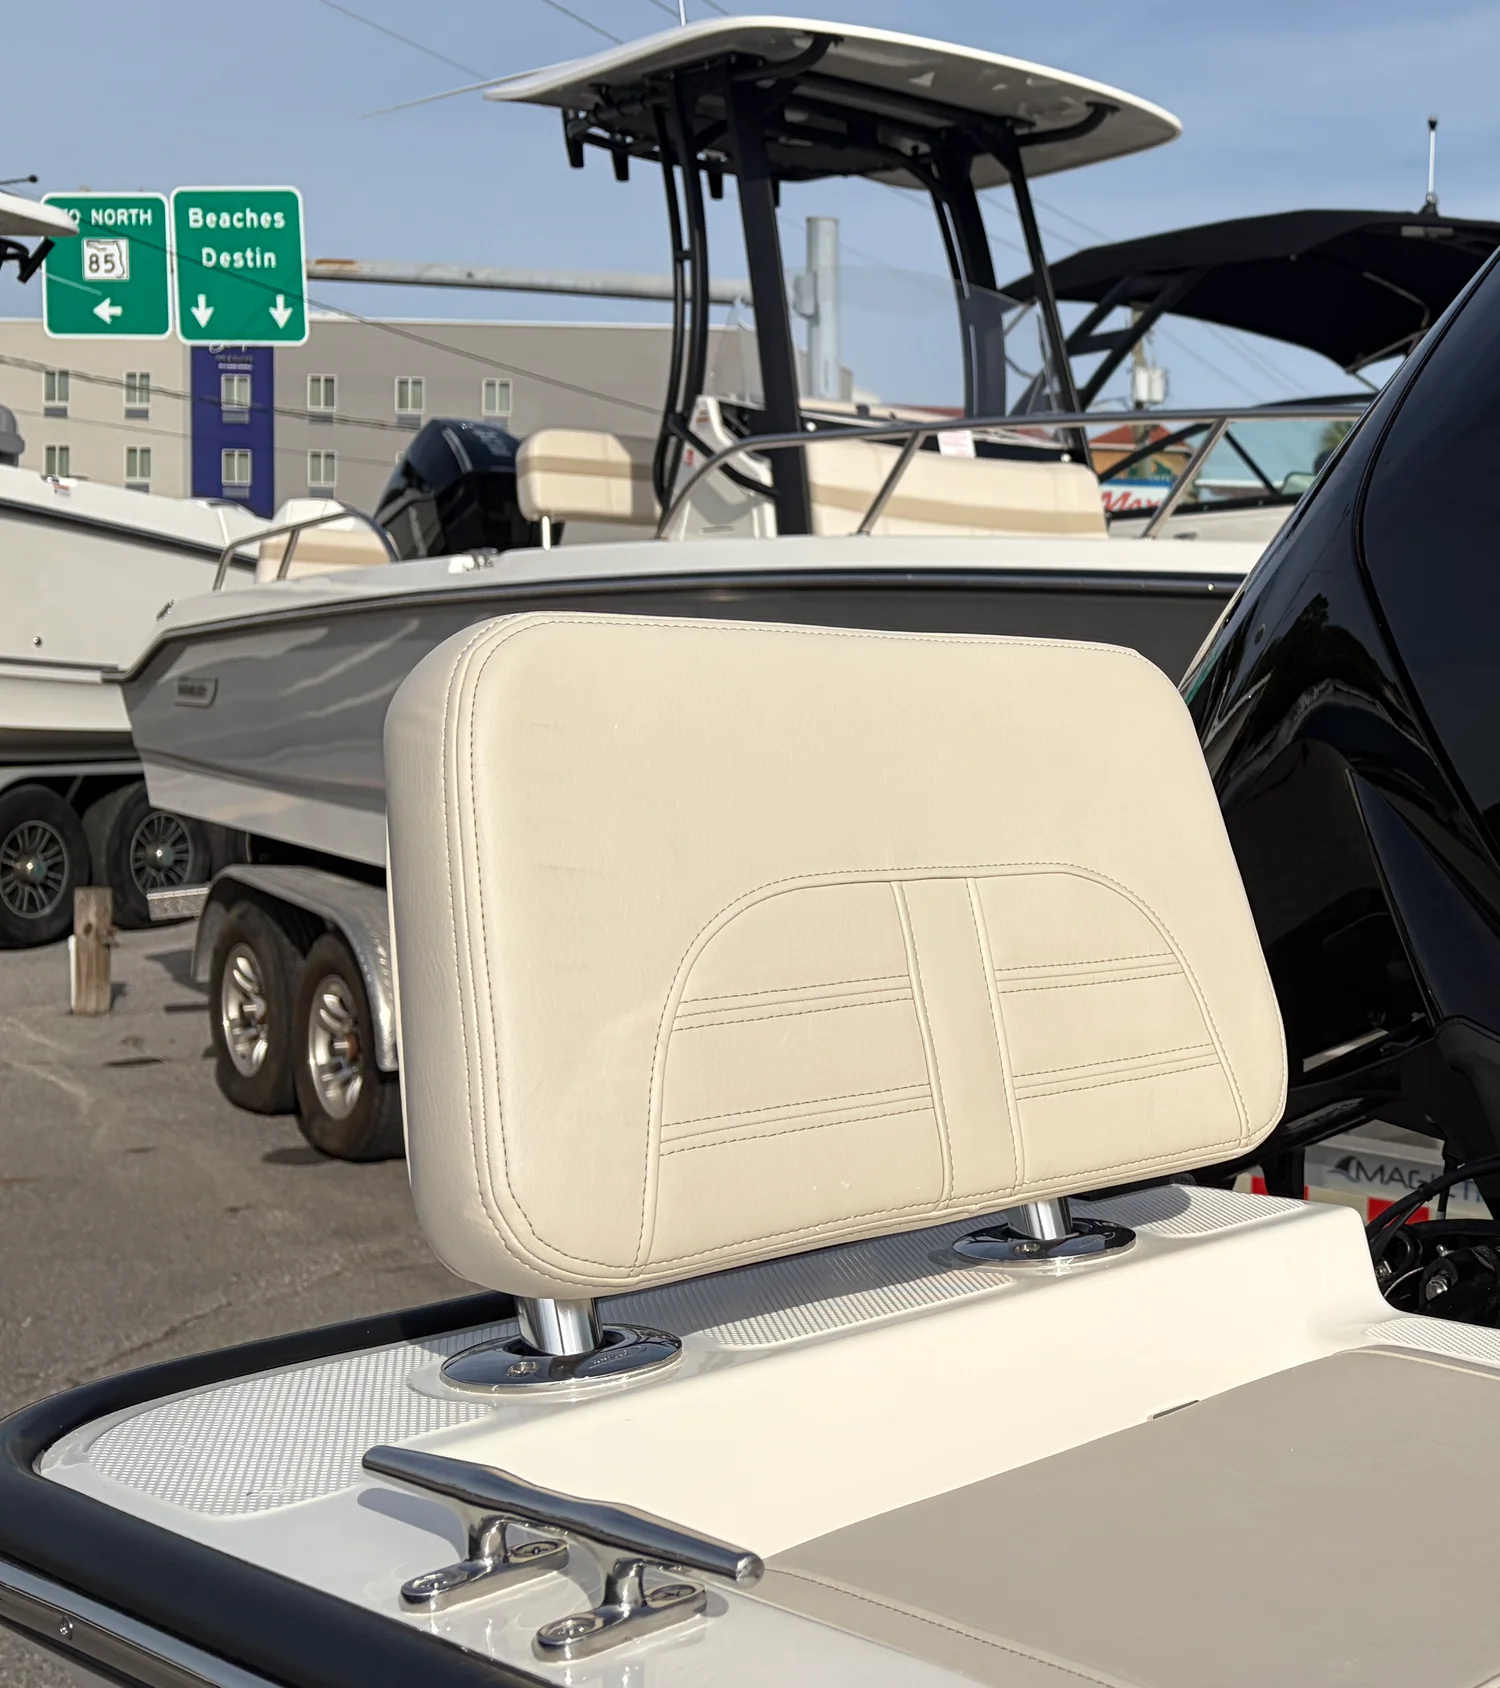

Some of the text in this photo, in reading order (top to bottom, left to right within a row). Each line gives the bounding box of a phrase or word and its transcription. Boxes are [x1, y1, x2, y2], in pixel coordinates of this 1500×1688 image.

[91, 208, 152, 226] NORTH
[188, 207, 285, 229] Beaches
[88, 253, 115, 273] 85
[201, 246, 277, 268] Destin
